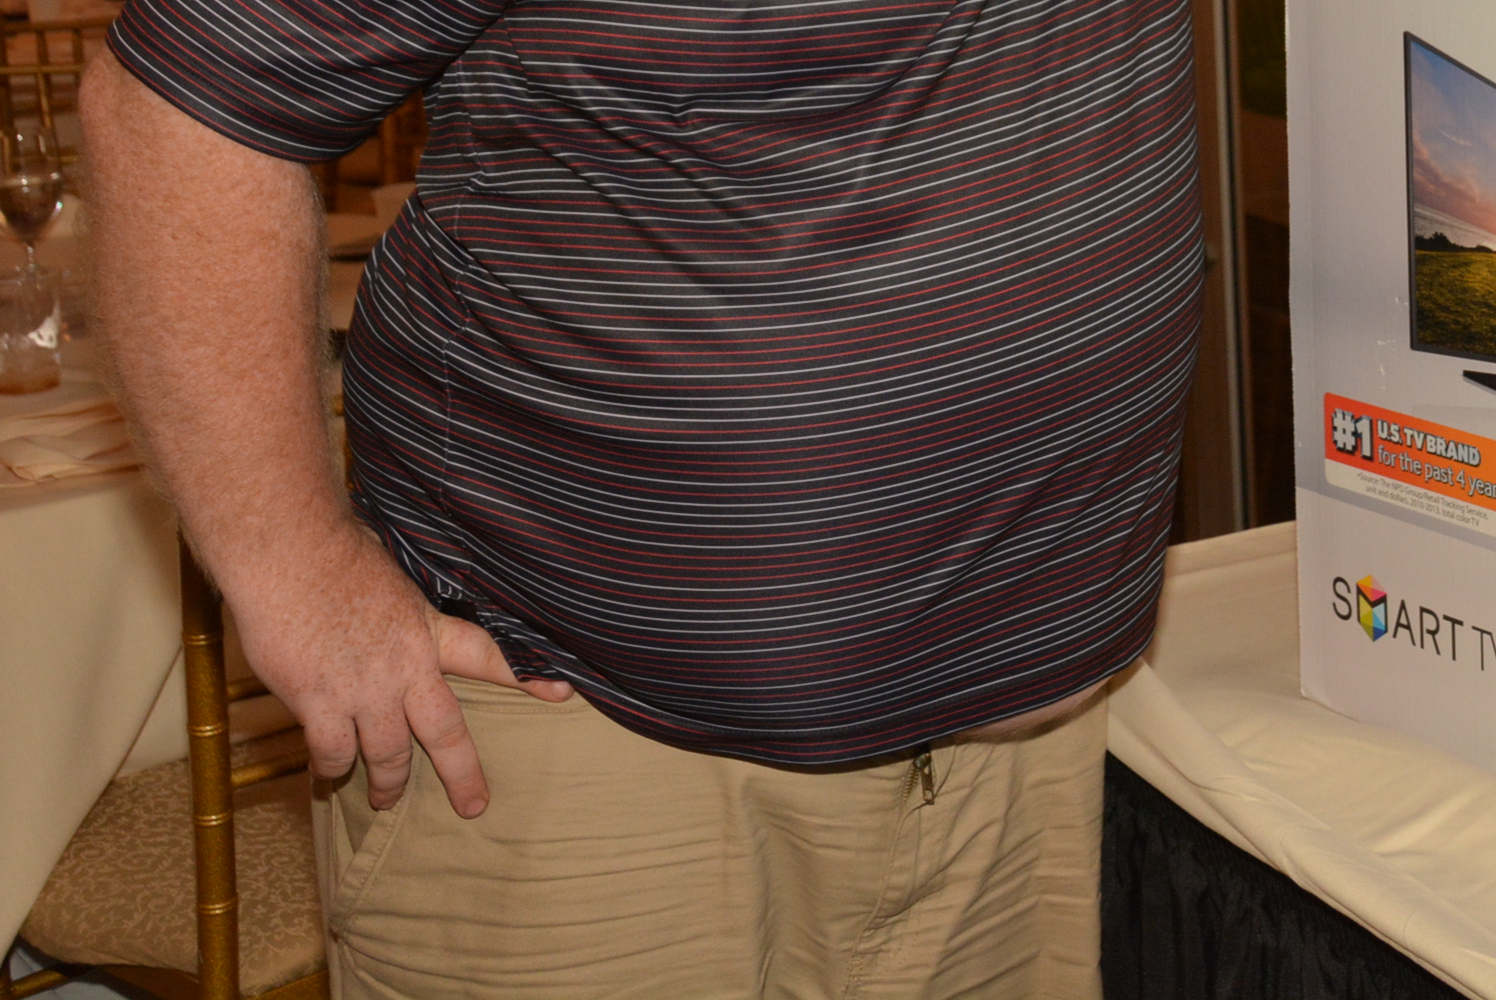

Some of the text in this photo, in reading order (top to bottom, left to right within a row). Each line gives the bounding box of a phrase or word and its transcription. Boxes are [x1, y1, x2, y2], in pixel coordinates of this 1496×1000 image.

[1332, 408, 1373, 460] #1
[1377, 419, 1481, 467] U.S. TV BRAND
[1378, 445, 1397, 467] for
[1399, 453, 1422, 475] the
[1425, 463, 1454, 486] past
[1456, 469, 1465, 489] 4
